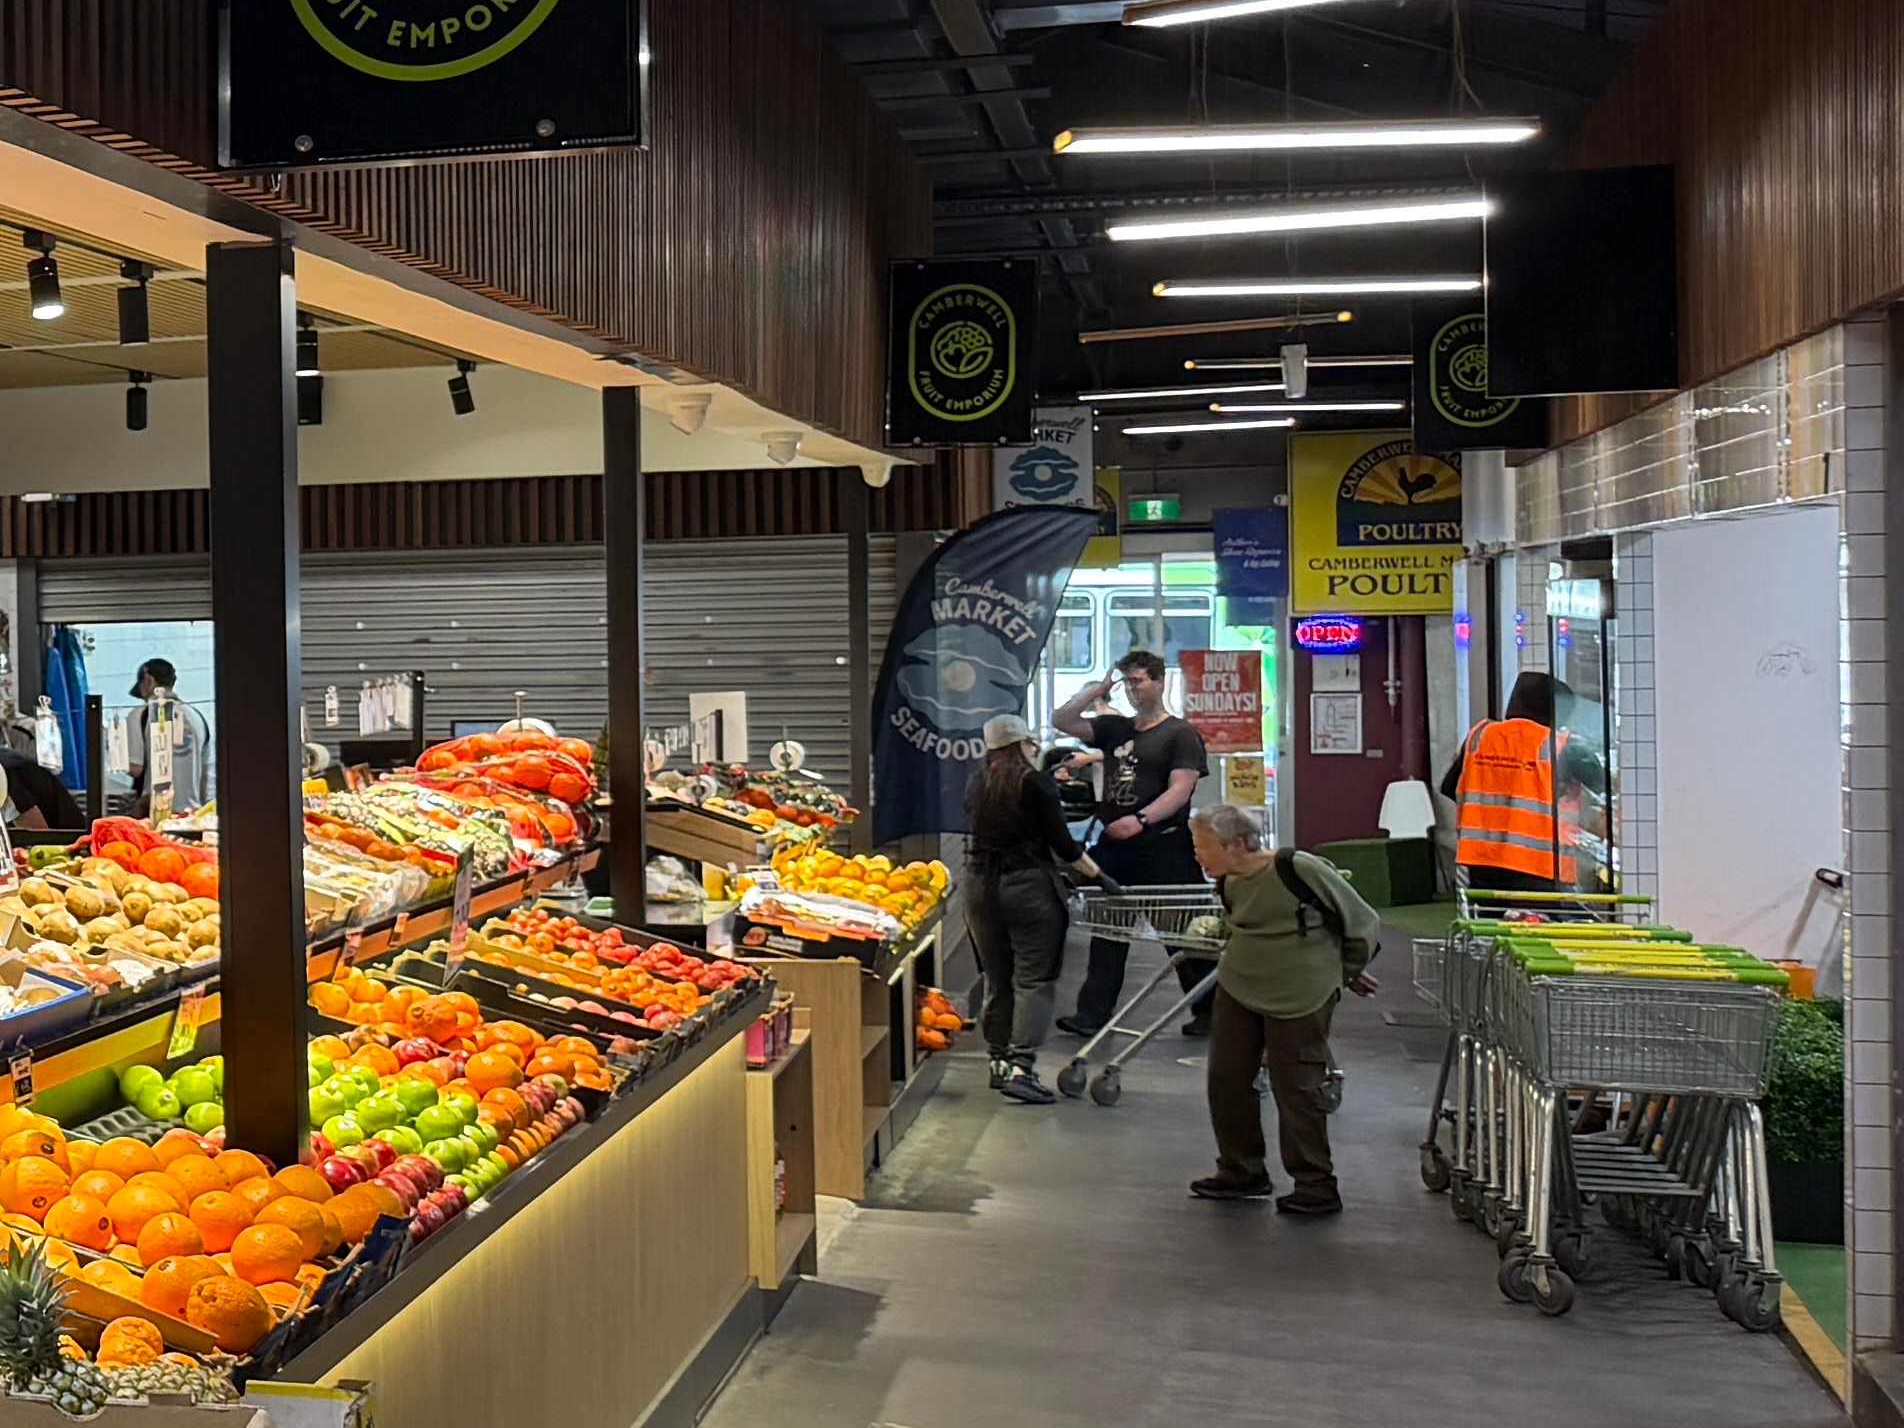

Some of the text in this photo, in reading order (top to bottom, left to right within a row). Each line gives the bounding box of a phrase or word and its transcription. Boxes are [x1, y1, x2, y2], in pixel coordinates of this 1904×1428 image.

[918, 294, 1007, 329] CAMBERWELL
[919, 369, 1004, 411] FRUIT EMPORIUM
[1340, 440, 1412, 498] CAMBERWE
[1359, 522, 1462, 541] POULTRY
[1309, 555, 1454, 571] CAMBERWELL M
[1328, 573, 1449, 596] POULT
[944, 578, 1041, 619] Camberwell
[931, 597, 1037, 645] MARKET
[1296, 624, 1360, 642] OPEN
[1204, 653, 1239, 672] NOW
[1202, 674, 1240, 691] OPEN
[1186, 693, 1257, 712] SUNDAYS!
